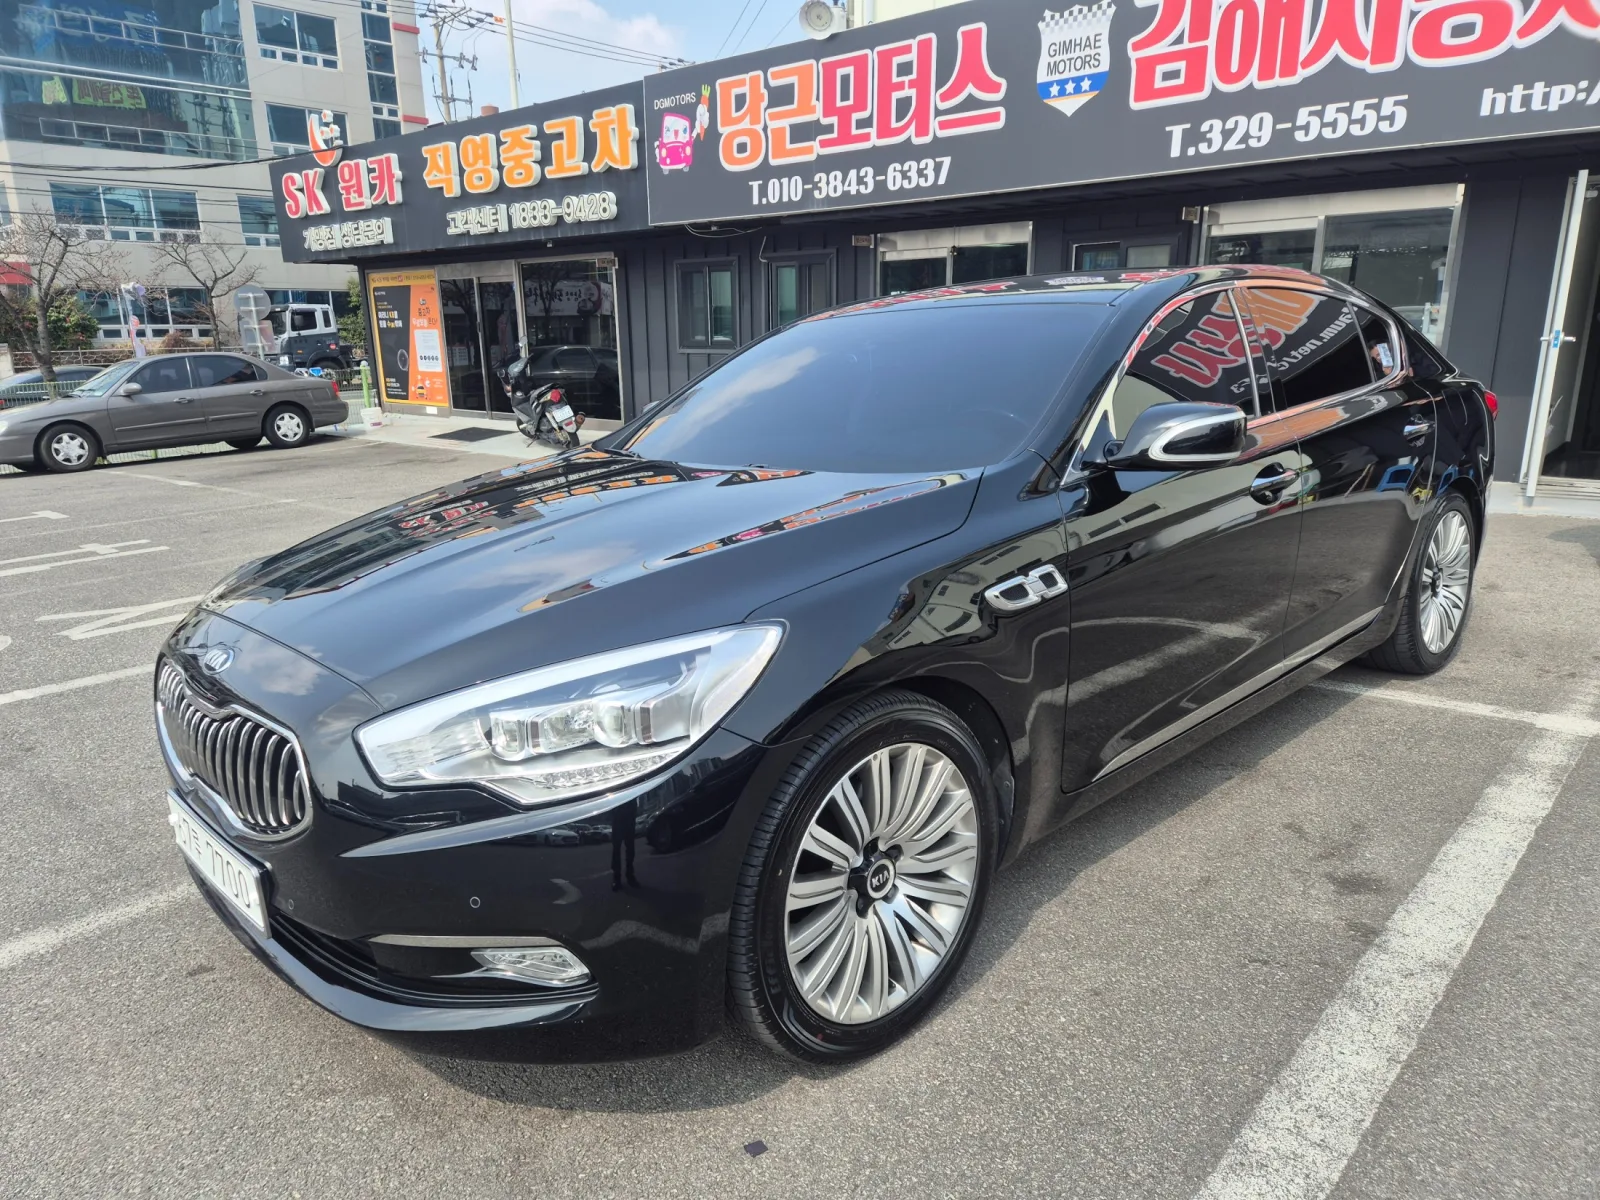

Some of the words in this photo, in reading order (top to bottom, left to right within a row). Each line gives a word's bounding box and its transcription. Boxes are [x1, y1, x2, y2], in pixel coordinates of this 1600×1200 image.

[1046, 52, 1101, 77] MOTORS
[1047, 33, 1102, 58] GIMHAE
[654, 92, 696, 110] DGMOTORS
[716, 22, 1006, 171] 당근모터스
[423, 103, 639, 198] 직영중고차
[1165, 95, 1409, 158] T.329-5555
[282, 168, 330, 218] SK
[337, 153, 402, 211] 원카
[749, 157, 952, 205] T.010-3843-6337
[446, 204, 508, 235] 고객센터
[509, 190, 618, 229] 1833-9428
[206, 839, 251, 909] 7700
[871, 871, 890, 889] KIA
